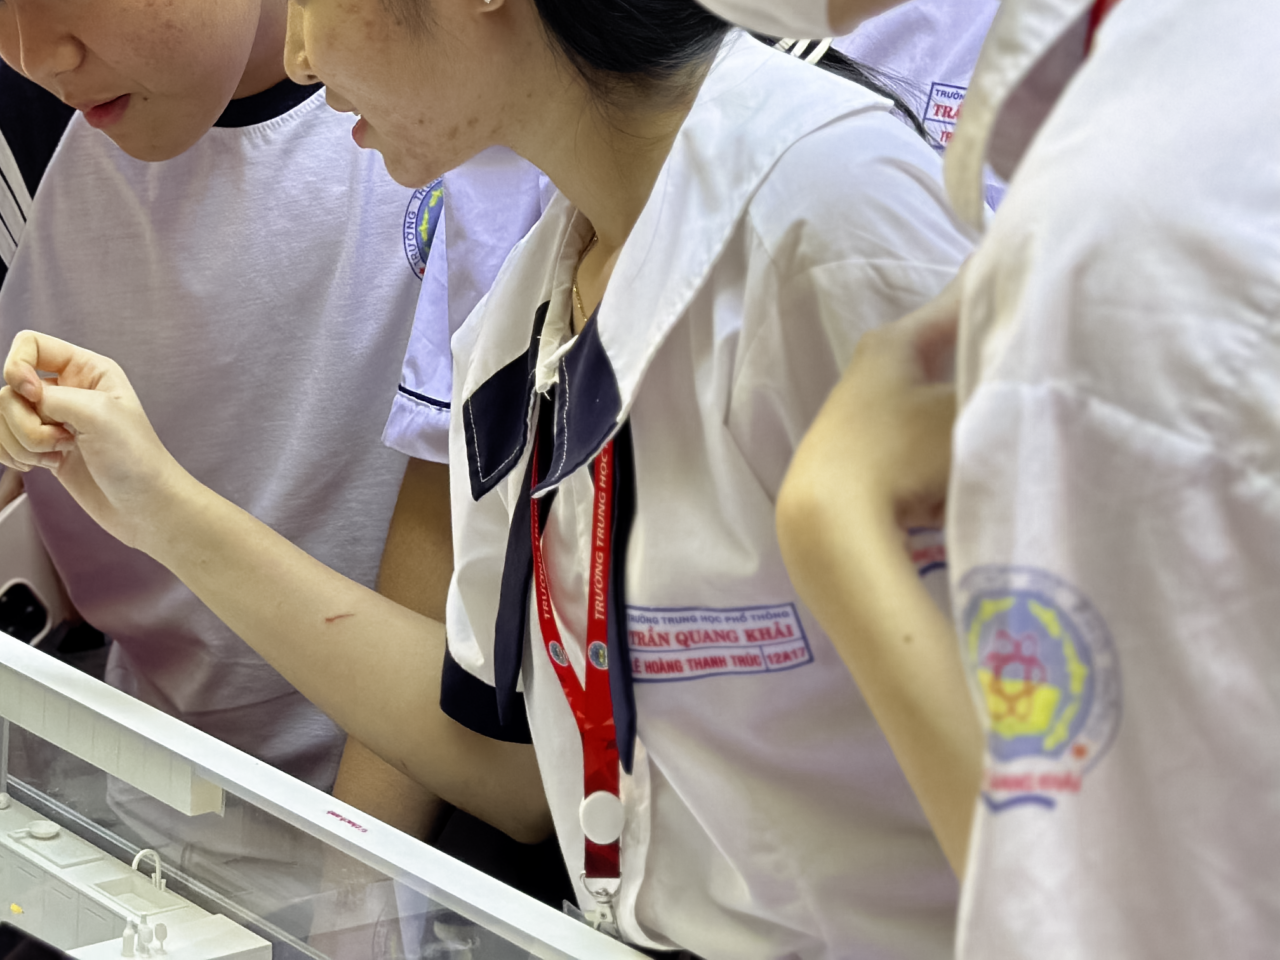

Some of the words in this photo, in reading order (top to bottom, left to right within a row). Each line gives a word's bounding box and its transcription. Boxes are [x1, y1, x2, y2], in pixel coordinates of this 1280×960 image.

[935, 89, 966, 101] TRƯỜN
[933, 102, 964, 120] TR
[599, 450, 609, 489] HỌC
[597, 492, 606, 547] TRUNG
[595, 553, 605, 620] TRƯỜNG
[661, 615, 698, 625] TRUNG
[700, 614, 722, 624] HỌC
[724, 611, 748, 623] PHỐ
[750, 610, 790, 622] THÔNG
[628, 625, 671, 647] TRẦN
[675, 629, 739, 648] QUANG
[744, 621, 794, 643] KHẢI
[644, 657, 684, 674] HOÀNG
[686, 655, 728, 672] THANH
[730, 651, 762, 667] TRÚC
[767, 646, 806, 665] 12A17
